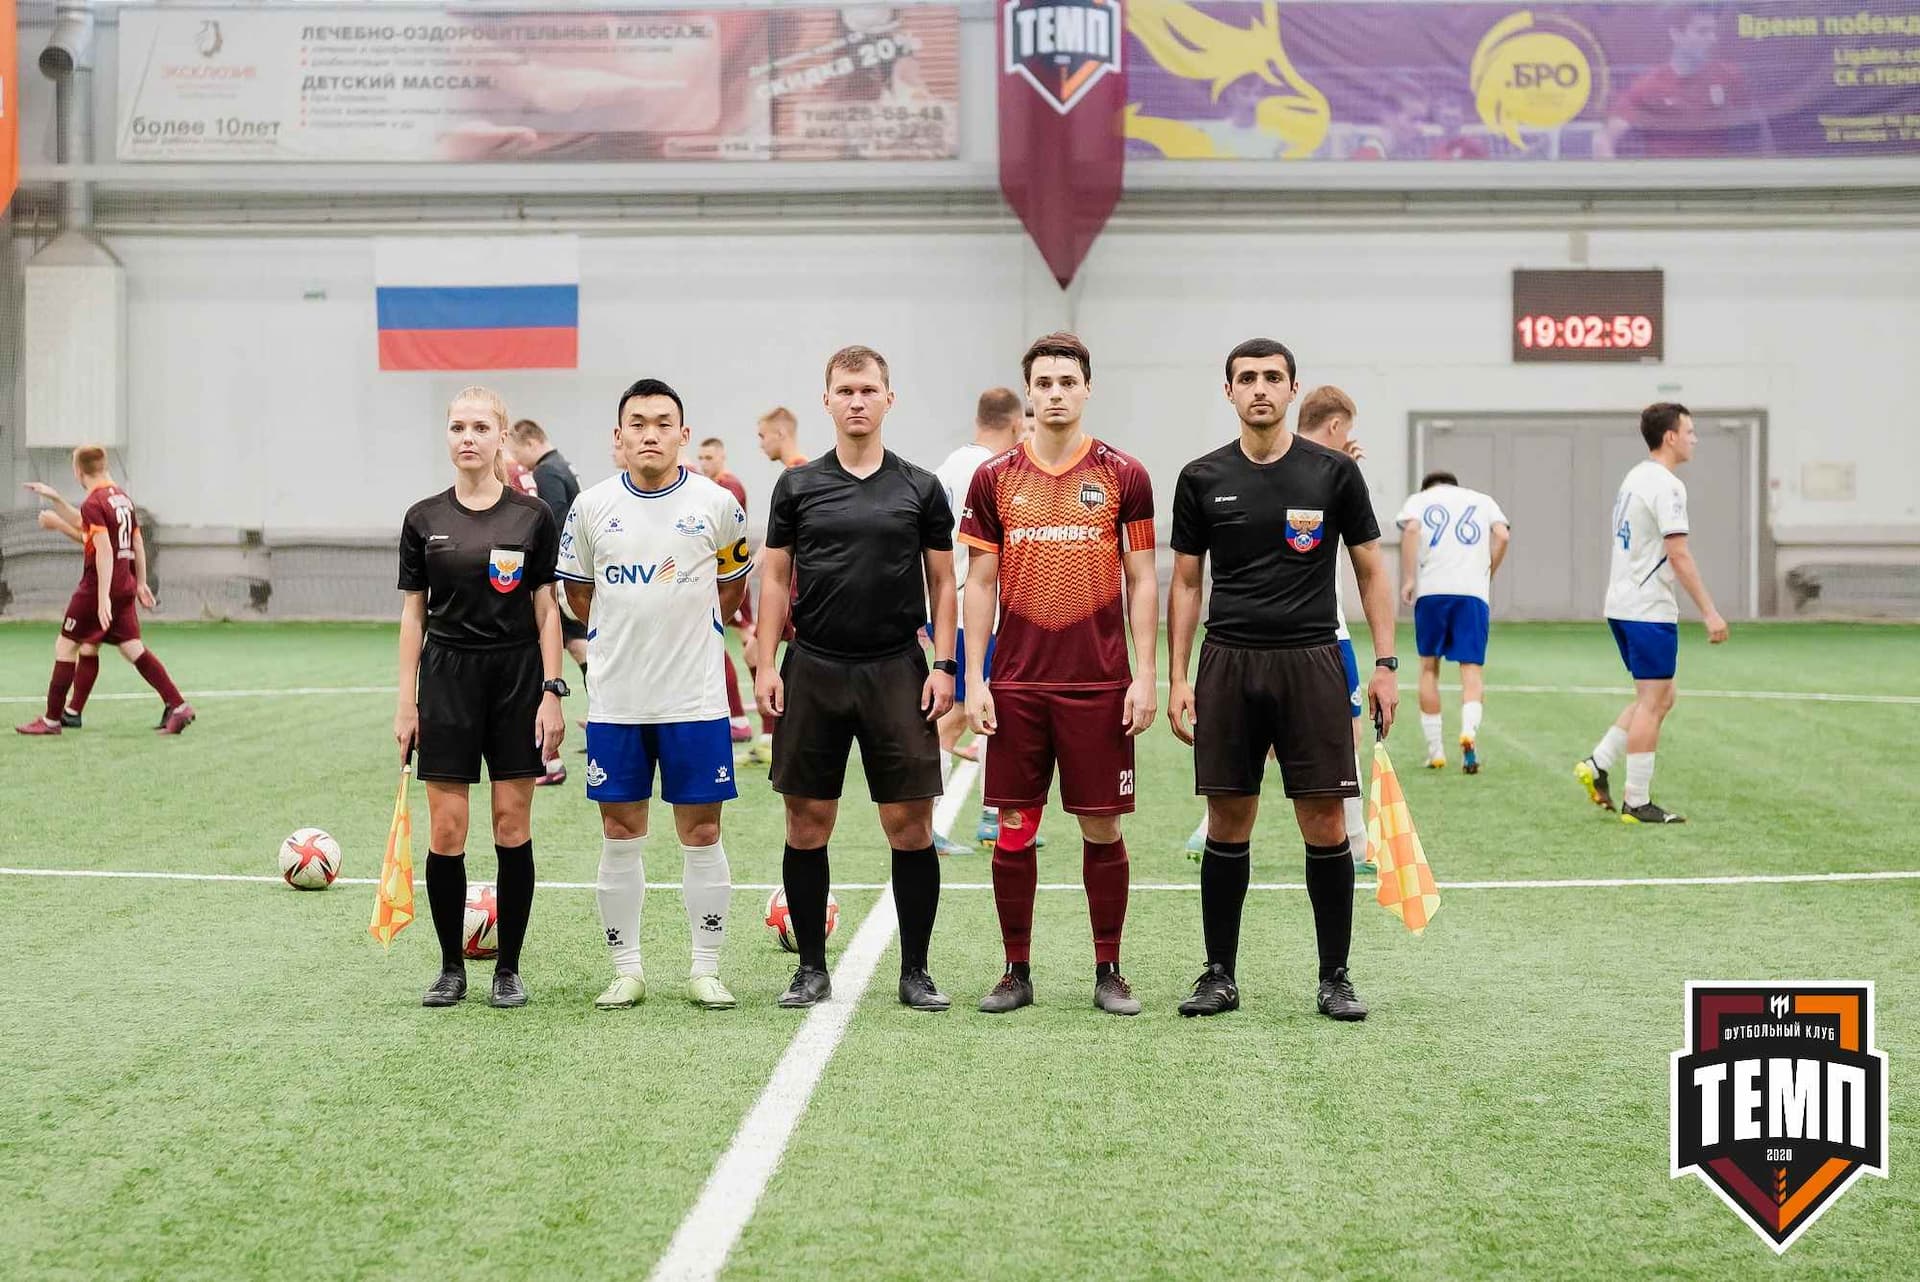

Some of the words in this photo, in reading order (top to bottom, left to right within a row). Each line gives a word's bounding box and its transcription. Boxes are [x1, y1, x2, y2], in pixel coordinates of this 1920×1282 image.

[1016, 6, 1110, 56] ТЕМП
[1738, 14, 1818, 40] Время
[301, 73, 395, 91] ДЕТСКИЙ
[132, 116, 205, 136] более
[215, 116, 281, 137] 10лет
[1517, 314, 1653, 349] 19:02:59
[1423, 503, 1481, 548] 96
[605, 564, 658, 585] GNV
[1119, 770, 1134, 796] 23
